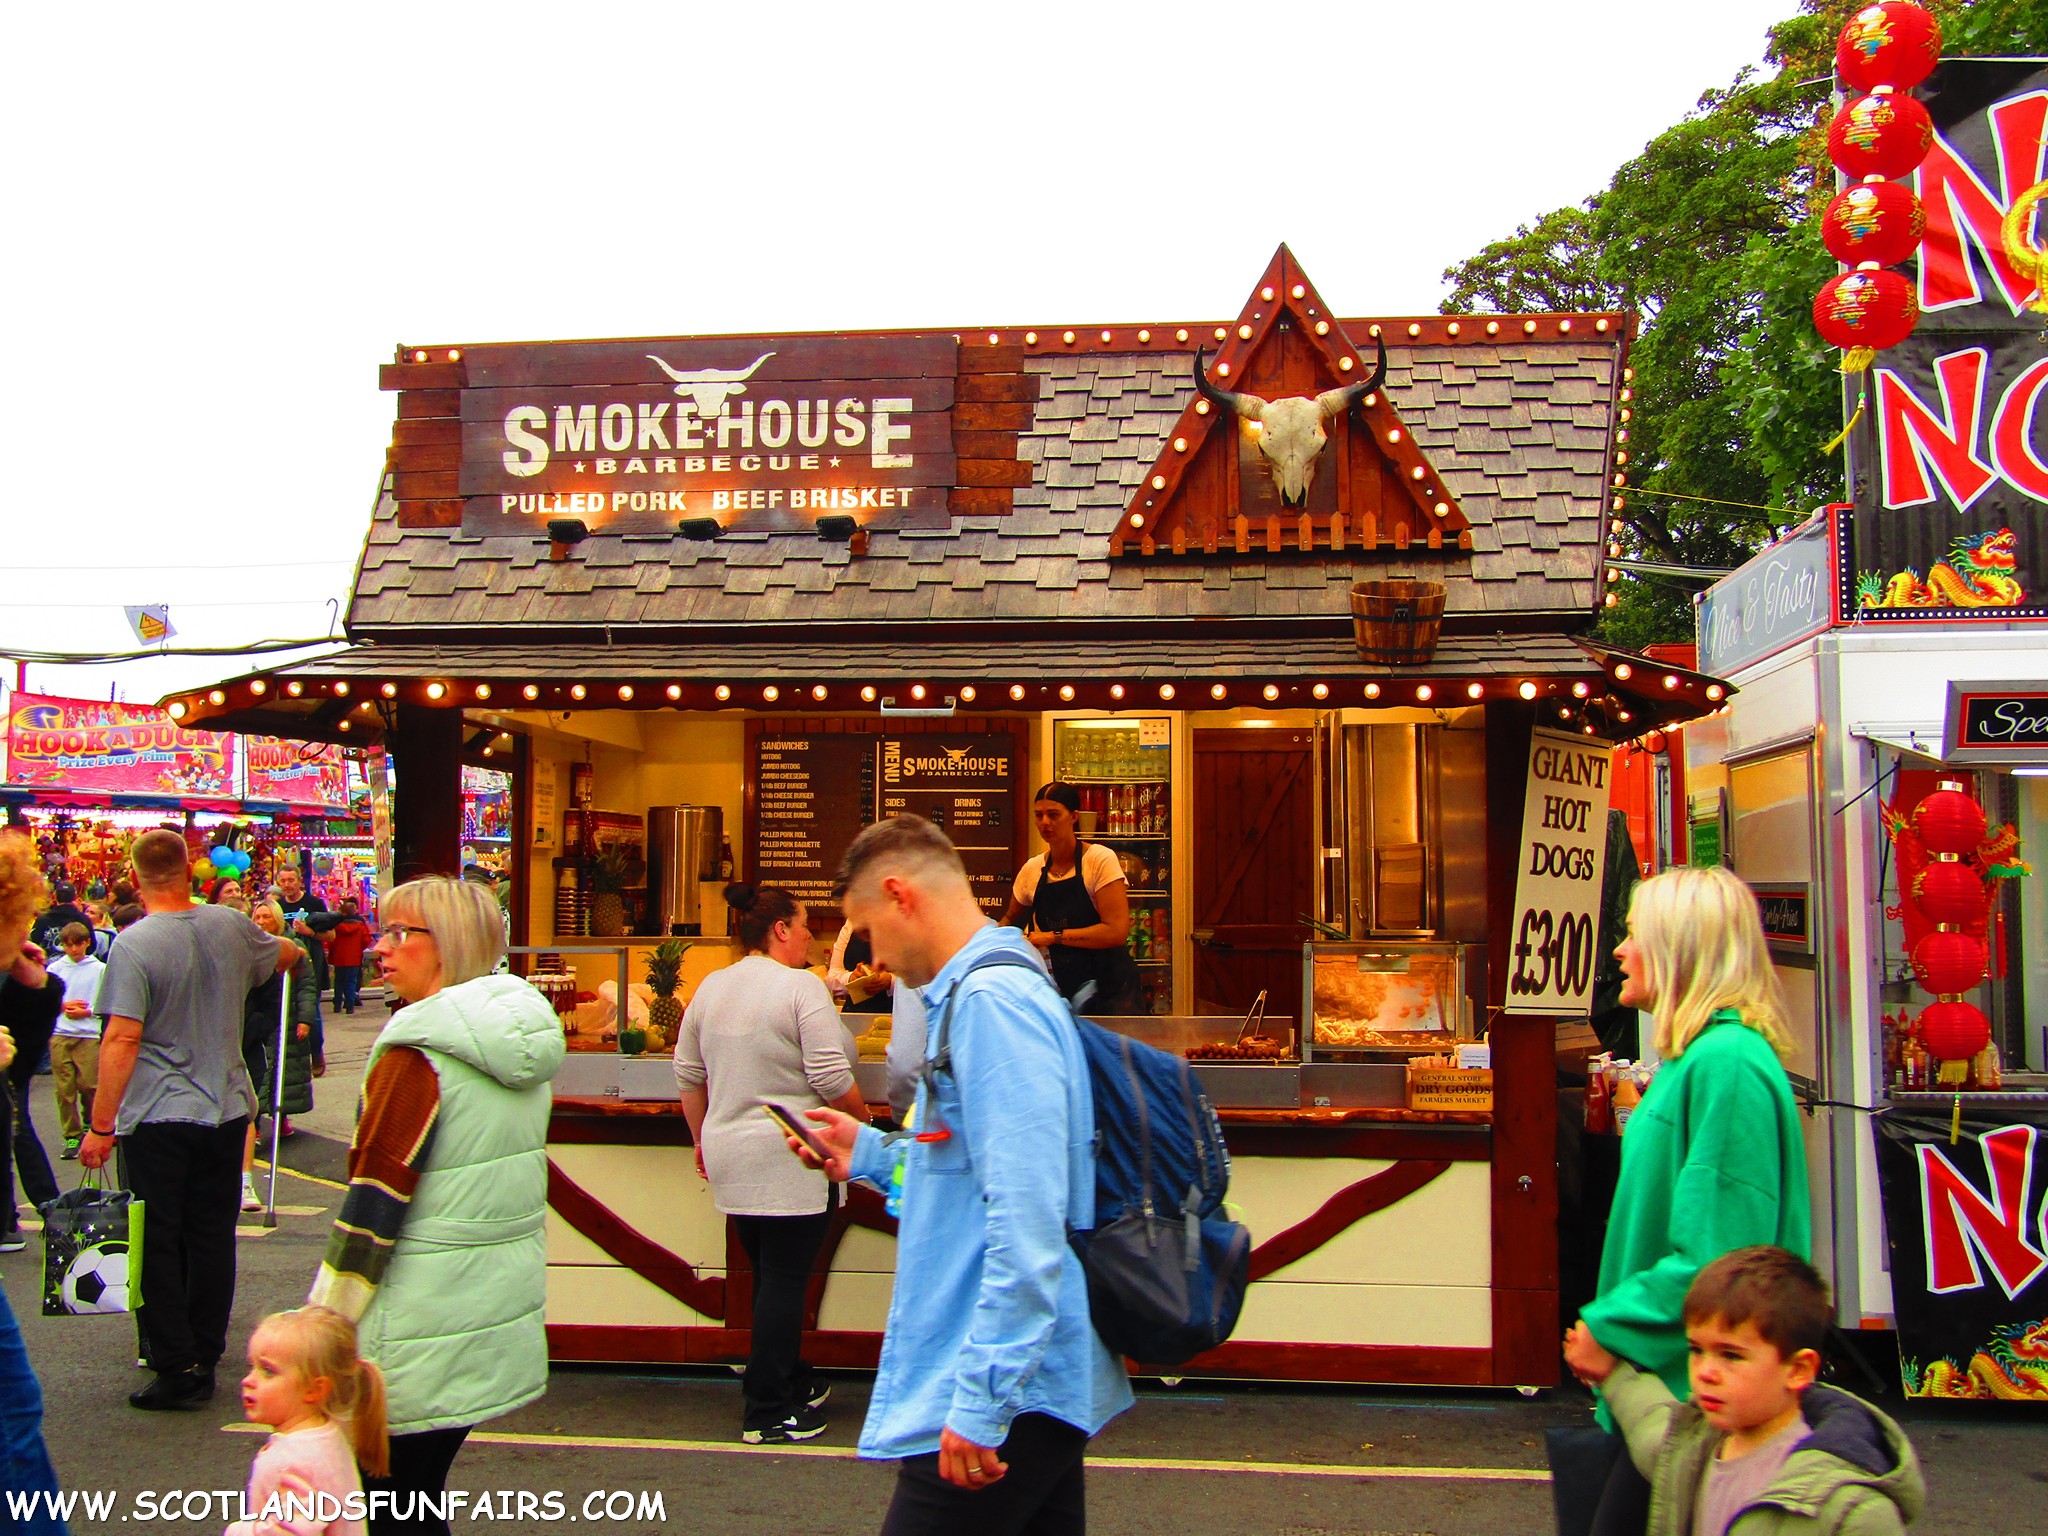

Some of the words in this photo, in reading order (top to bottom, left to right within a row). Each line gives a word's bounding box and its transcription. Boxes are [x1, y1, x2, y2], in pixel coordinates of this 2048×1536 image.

[595, 454, 820, 475] BARBECUE
[502, 492, 605, 514] PULLED
[612, 490, 687, 512] PORK
[712, 489, 784, 510] BEEF
[790, 487, 913, 509] BRISKET
[1705, 603, 1740, 660] Nice
[1743, 577, 1759, 646] &
[1764, 560, 1818, 634] Tasty
[14, 729, 110, 754] HOOK
[112, 732, 127, 747] A
[130, 726, 215, 749] DUCK
[761, 741, 809, 751] SANDWICHES
[58, 756, 95, 769] Prize
[98, 752, 138, 768] Every
[141, 750, 176, 763] Time
[250, 744, 292, 767] HOOK
[884, 741, 900, 783] MENU
[1532, 746, 1608, 789] GIANT
[884, 798, 906, 807] SIDES
[954, 798, 982, 807] DRINKS
[1542, 794, 1591, 833] HOT
[1530, 842, 1595, 881] DOGS
[980, 898, 1002, 906] MEAL!
[1416, 1084, 1442, 1094] DRY
[1446, 1084, 1491, 1094] GOODS
[1915, 1124, 2048, 1300] N
